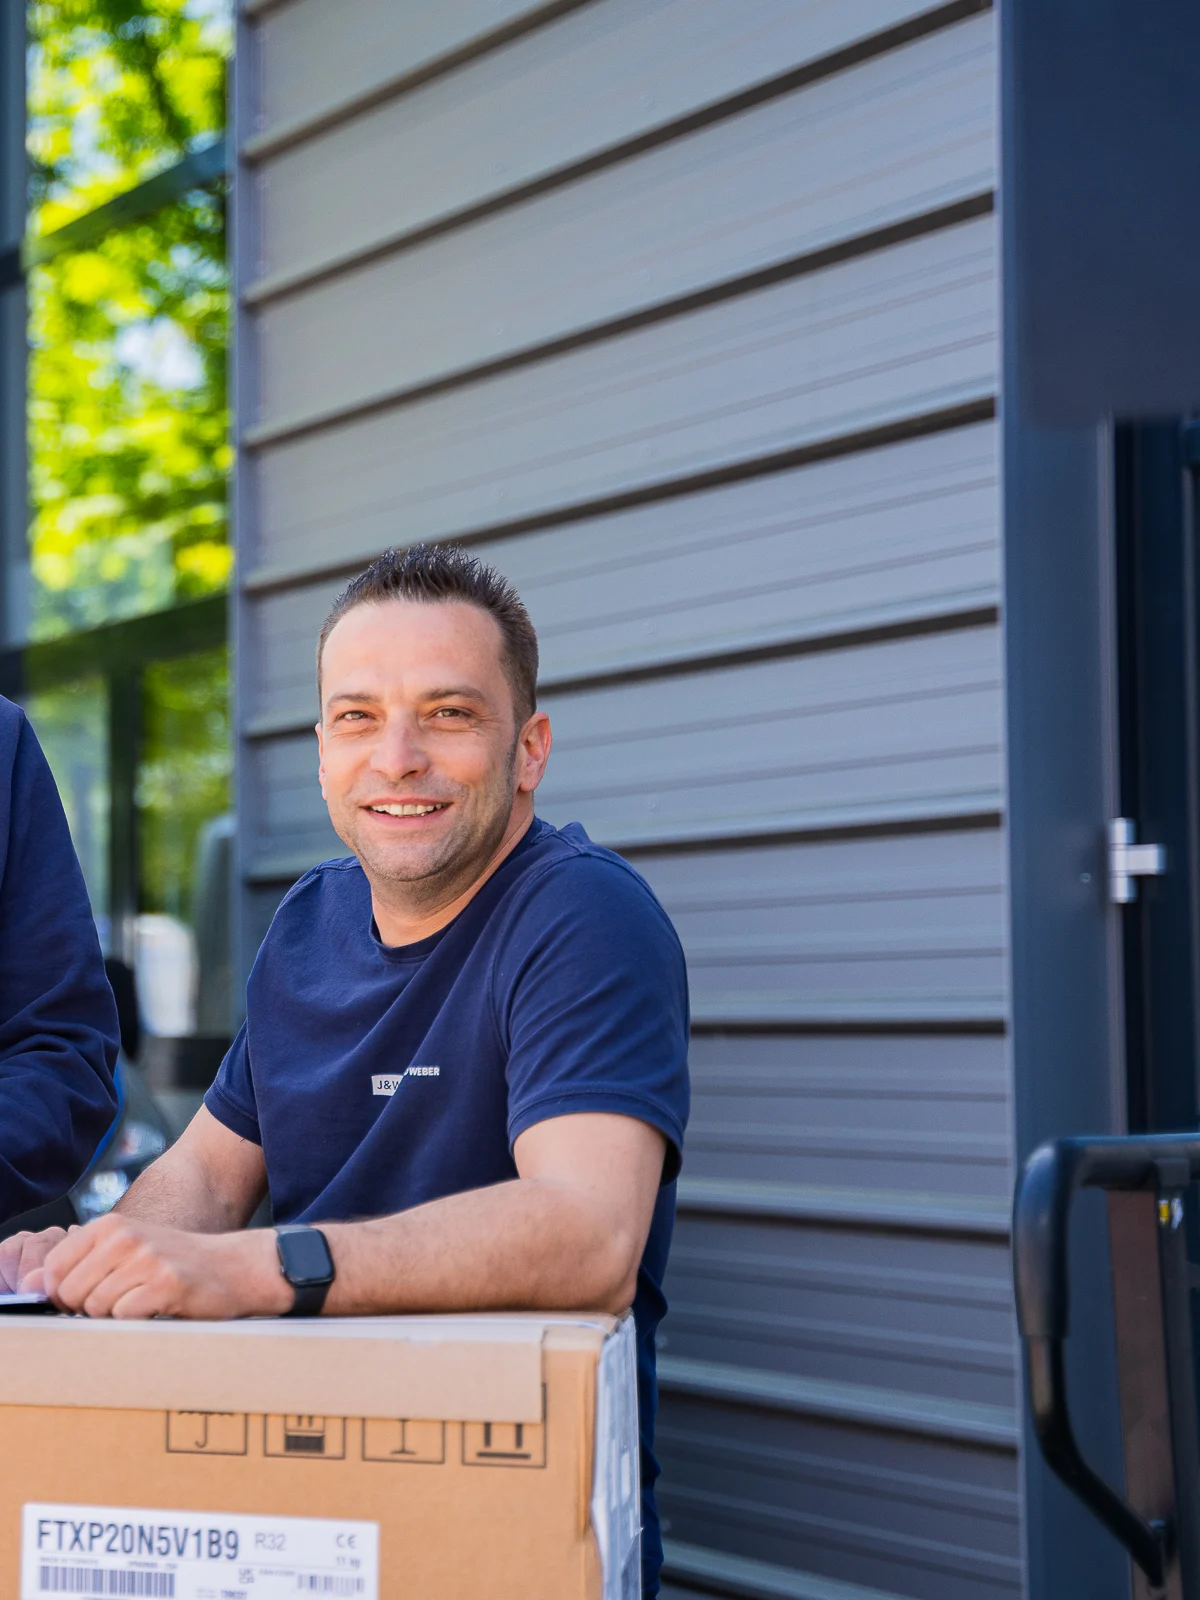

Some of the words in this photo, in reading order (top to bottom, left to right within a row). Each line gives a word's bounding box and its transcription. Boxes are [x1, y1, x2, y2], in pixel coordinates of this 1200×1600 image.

[409, 1066, 440, 1076] WEBER
[37, 1519, 240, 1561] FTXP20N5V1B9
[255, 1532, 286, 1552] R32
